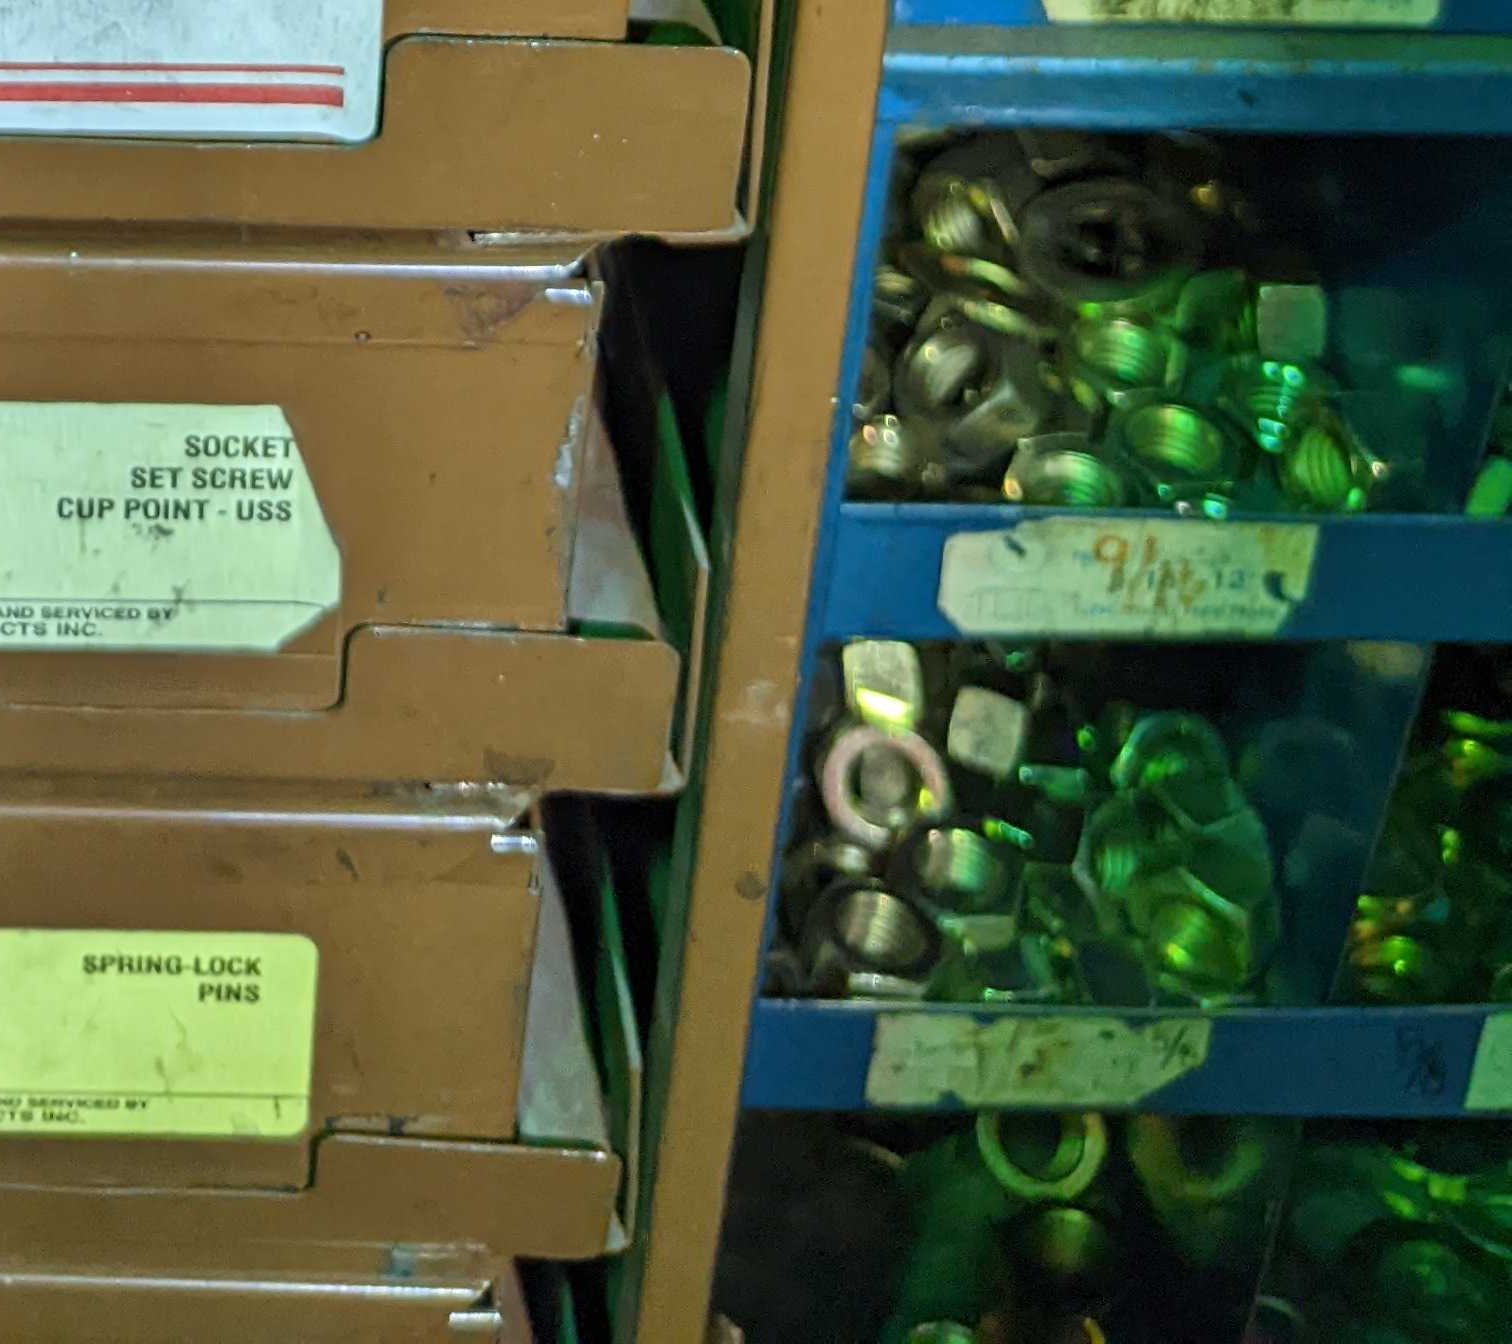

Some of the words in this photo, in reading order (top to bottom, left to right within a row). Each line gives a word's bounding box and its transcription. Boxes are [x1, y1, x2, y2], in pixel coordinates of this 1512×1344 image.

[184, 435, 296, 458] SOCKET
[131, 466, 183, 489] SET
[192, 468, 293, 490] SCREW
[57, 497, 115, 520] CUP
[123, 498, 210, 520] POINT
[236, 499, 292, 522] USS
[41, 605, 142, 620] SERVICED
[147, 607, 174, 620] BY
[56, 621, 103, 637] INC.
[82, 954, 262, 976] SPRING-LOCK
[198, 982, 260, 1002] PINS
